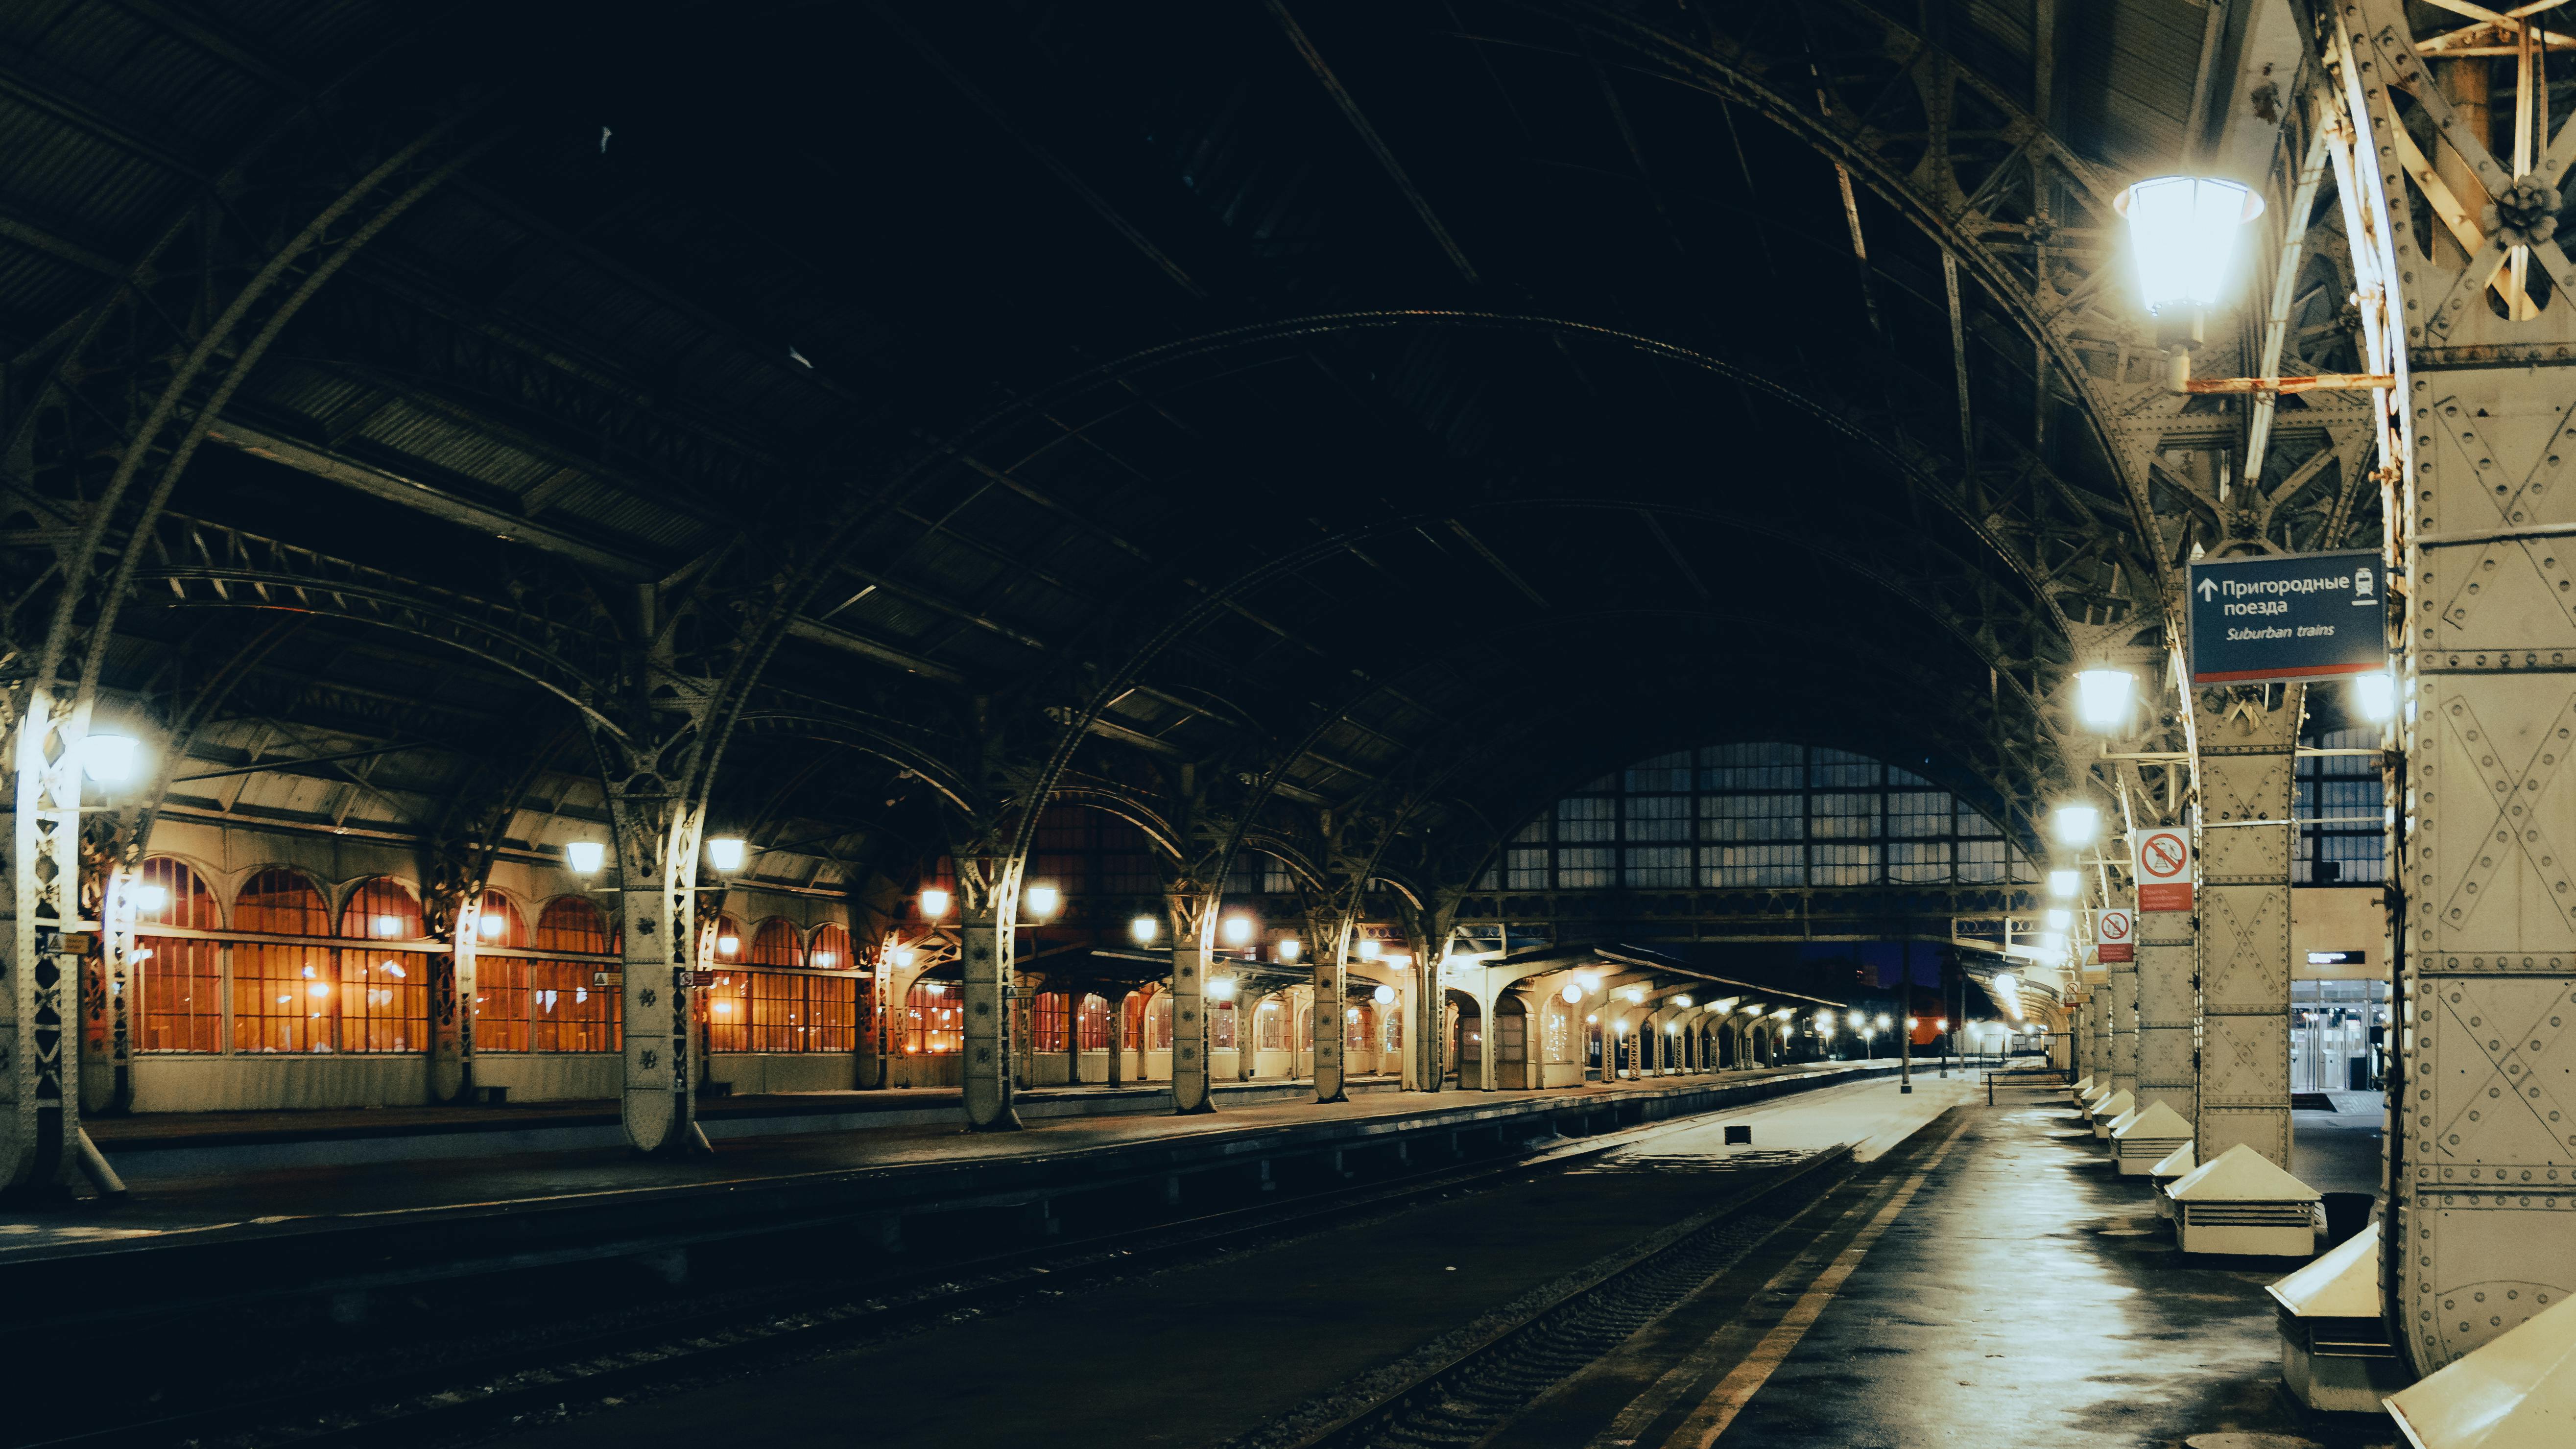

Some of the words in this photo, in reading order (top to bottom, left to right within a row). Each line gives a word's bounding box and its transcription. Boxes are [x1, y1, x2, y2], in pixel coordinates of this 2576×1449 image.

[2222, 576, 2350, 599] Пригородные
[2224, 601, 2288, 616] поезда
[2226, 626, 2292, 641] Suburban
[2297, 624, 2335, 637] trains
